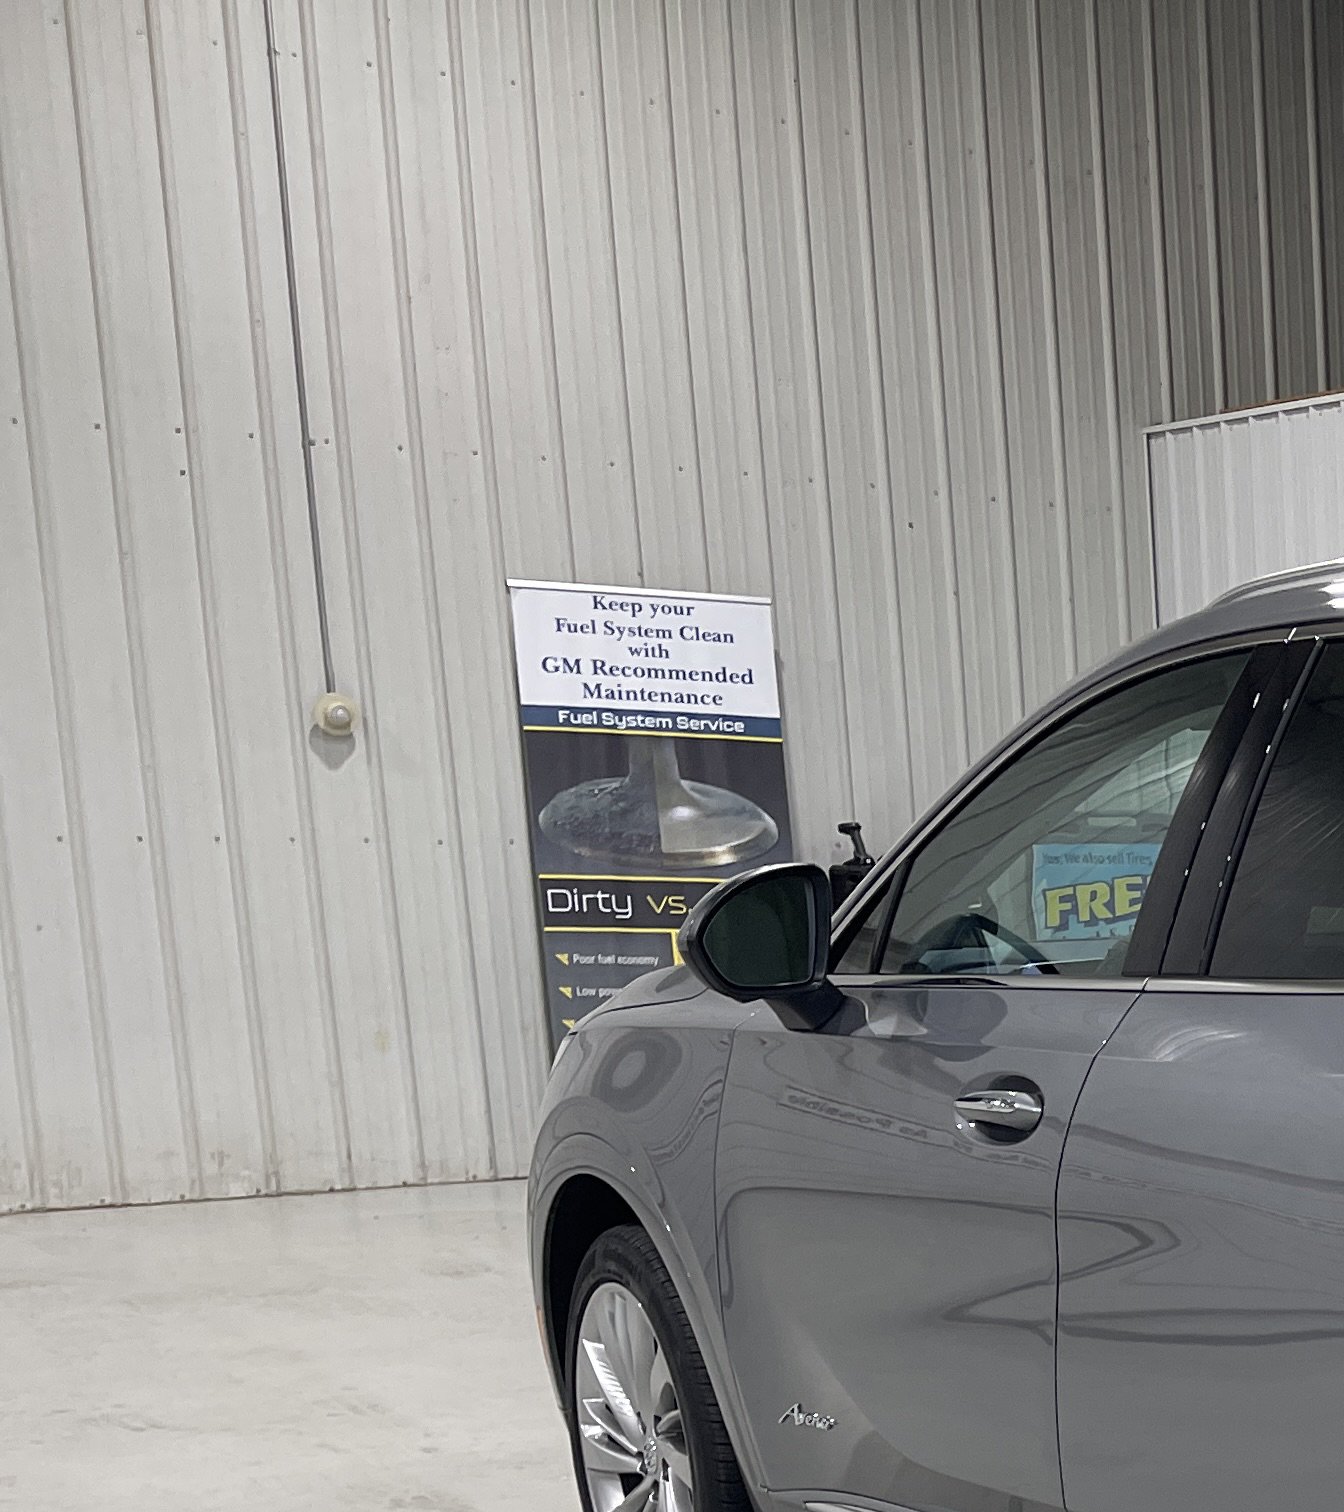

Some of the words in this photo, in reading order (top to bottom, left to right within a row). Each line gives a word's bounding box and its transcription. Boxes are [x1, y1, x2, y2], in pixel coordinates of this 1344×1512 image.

[593, 596, 643, 617] Keep
[649, 605, 695, 619] your
[555, 618, 596, 634] Fuel
[603, 621, 673, 641] System
[679, 625, 734, 643] Clean
[628, 643, 670, 659] with
[541, 656, 582, 675] GM
[591, 659, 754, 684] Recommended
[583, 683, 723, 706] Maintenance
[558, 710, 597, 725] Fuel
[602, 711, 673, 729] System
[677, 716, 744, 732] Service
[547, 888, 632, 919] Dirty
[1045, 875, 1151, 928] FRE
[573, 953, 595, 964] Poor
[576, 986, 596, 997] Low
